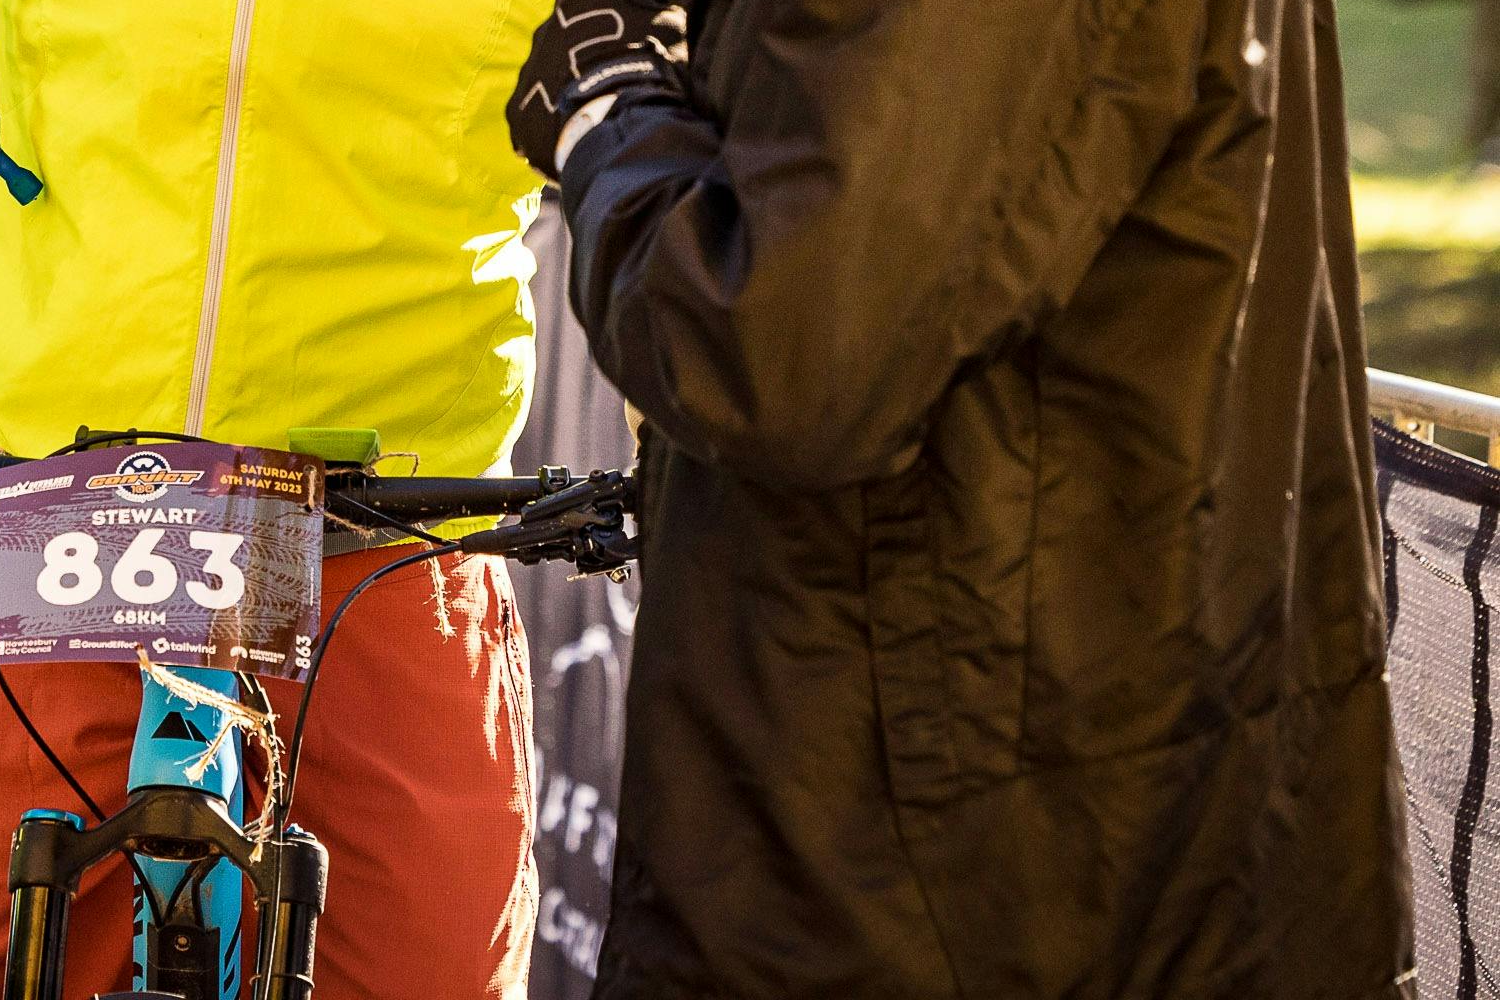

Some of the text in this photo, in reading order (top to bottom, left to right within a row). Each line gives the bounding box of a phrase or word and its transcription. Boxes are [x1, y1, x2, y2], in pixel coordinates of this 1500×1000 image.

[240, 464, 303, 481] SATURDAY
[220, 474, 302, 494] 6TH MAY 2023
[92, 508, 197, 525] STEWART
[36, 528, 245, 609] 863
[113, 610, 166, 625] 68KM
[21, 645, 51, 655] Council
[170, 641, 217, 655] tailwind
[295, 634, 312, 670] 863
